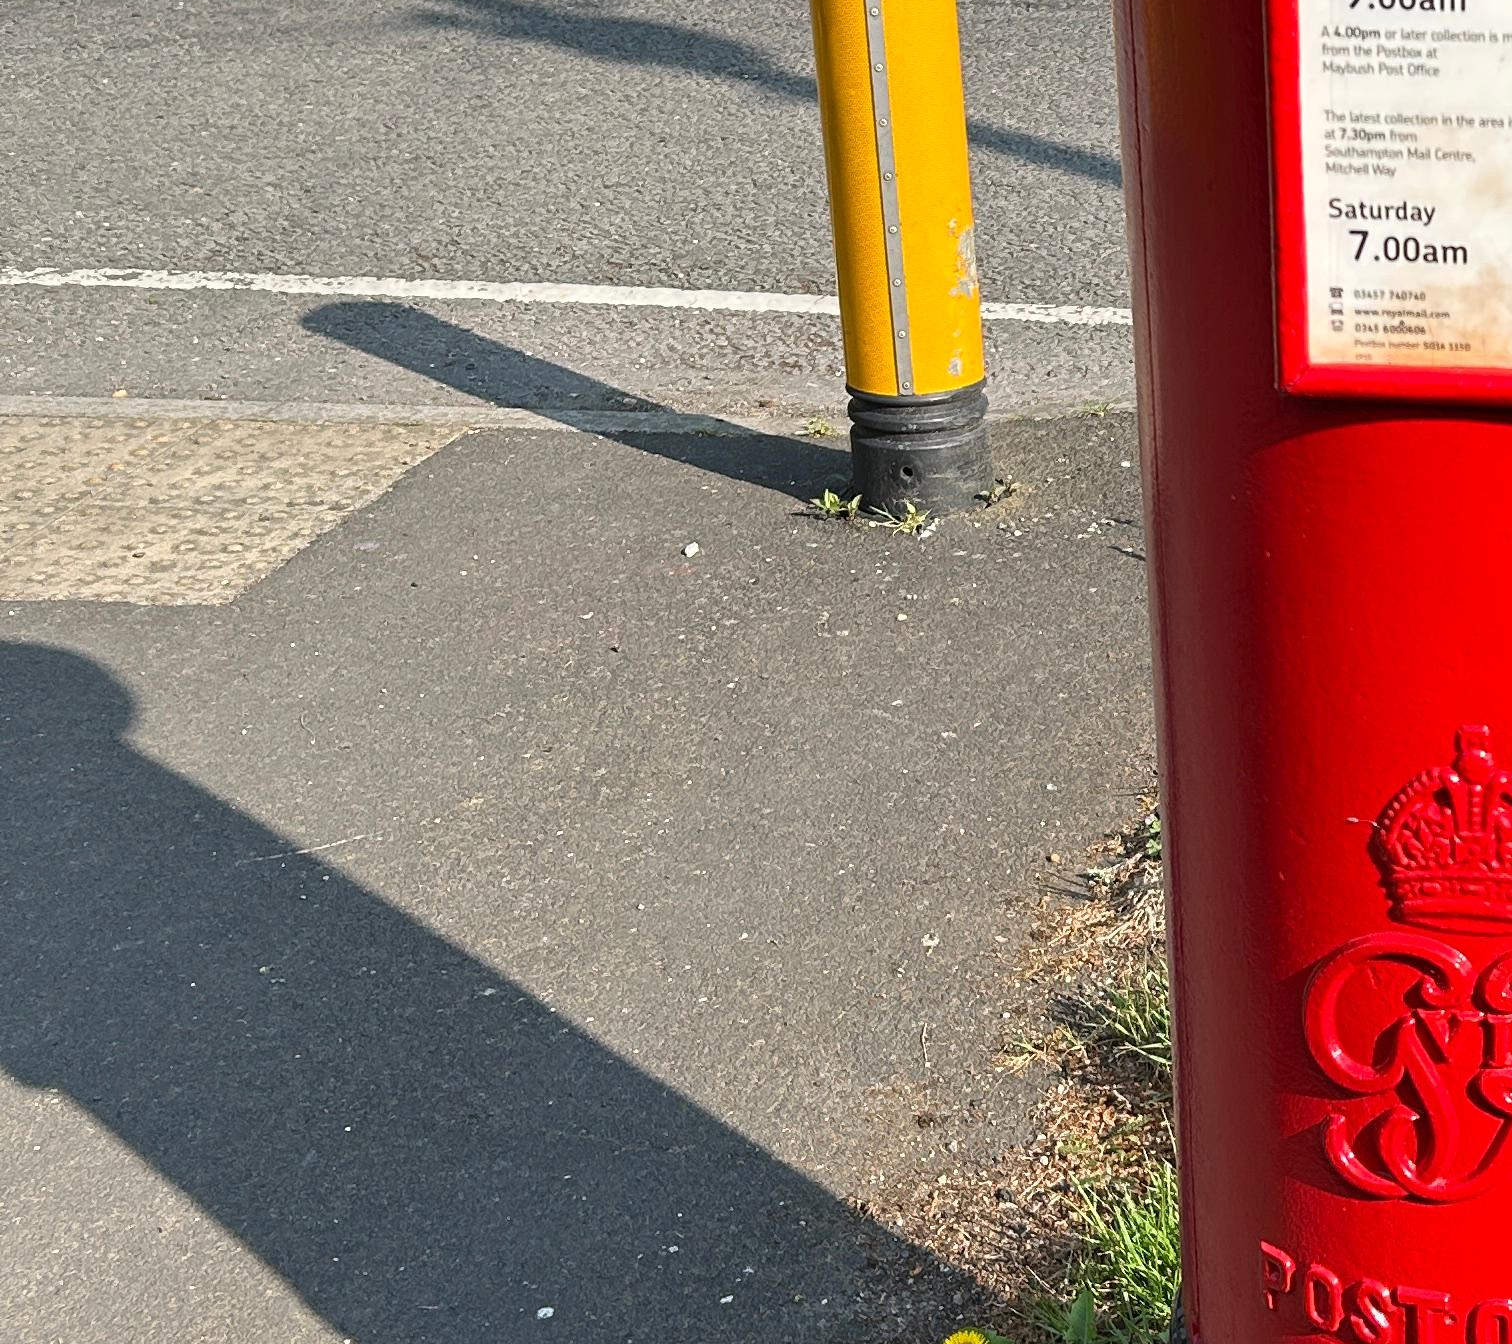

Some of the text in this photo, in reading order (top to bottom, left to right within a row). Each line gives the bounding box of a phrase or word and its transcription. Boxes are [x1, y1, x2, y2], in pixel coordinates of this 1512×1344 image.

[1321, 25, 1330, 37] A
[1333, 25, 1381, 41] 4.00pm
[1385, 30, 1397, 40] or
[1400, 27, 1426, 41] later
[1431, 28, 1486, 43] collection
[1489, 29, 1499, 43] is
[1322, 43, 1438, 59] from the Postbox at
[1323, 61, 1440, 77] Maybush Post Office
[1324, 109, 1346, 122] The
[1349, 111, 1380, 124] latest
[1385, 112, 1438, 126] collection
[1442, 114, 1453, 126] in
[1457, 115, 1475, 128] the
[1480, 118, 1504, 129] area
[1324, 127, 1418, 143] at 7.30pm from
[1325, 144, 1403, 161] Southampton
[1408, 147, 1431, 160] Mail
[1326, 161, 1396, 177] Mitchell Way
[1328, 198, 1436, 226] Saturday
[1349, 230, 1468, 264] 7.00am
